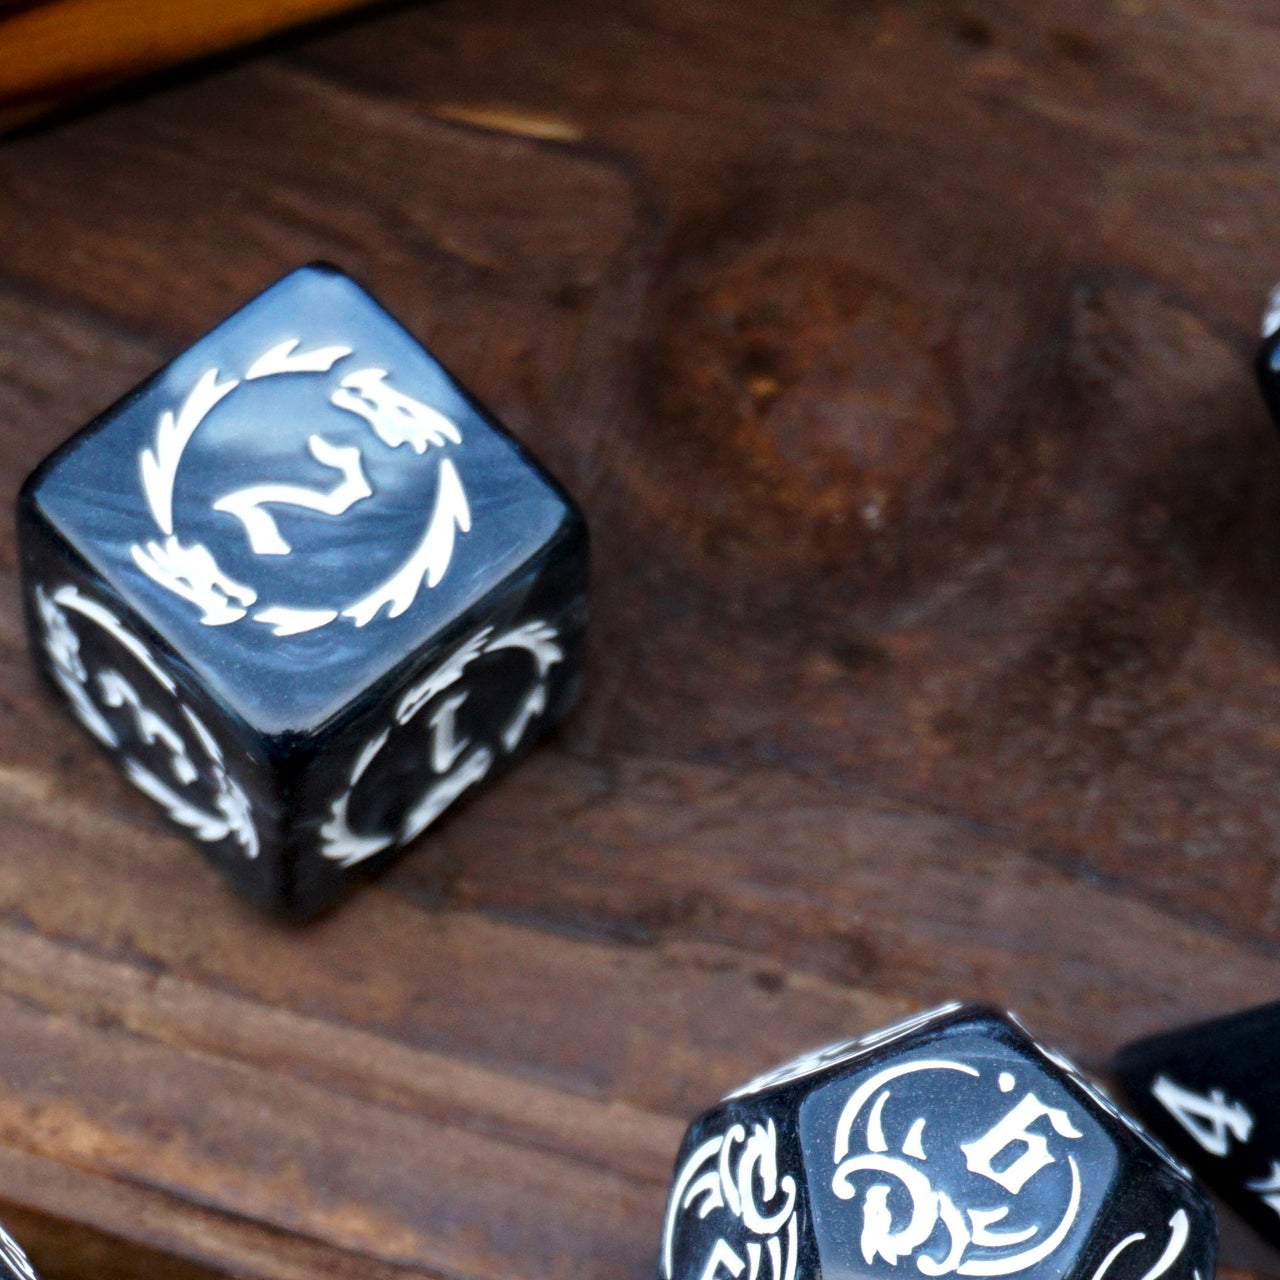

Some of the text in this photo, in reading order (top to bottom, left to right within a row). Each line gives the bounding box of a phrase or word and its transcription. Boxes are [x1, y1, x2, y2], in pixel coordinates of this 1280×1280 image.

[212, 432, 372, 556] 2
[99, 671, 197, 785] 3
[1153, 1078, 1253, 1155] 4
